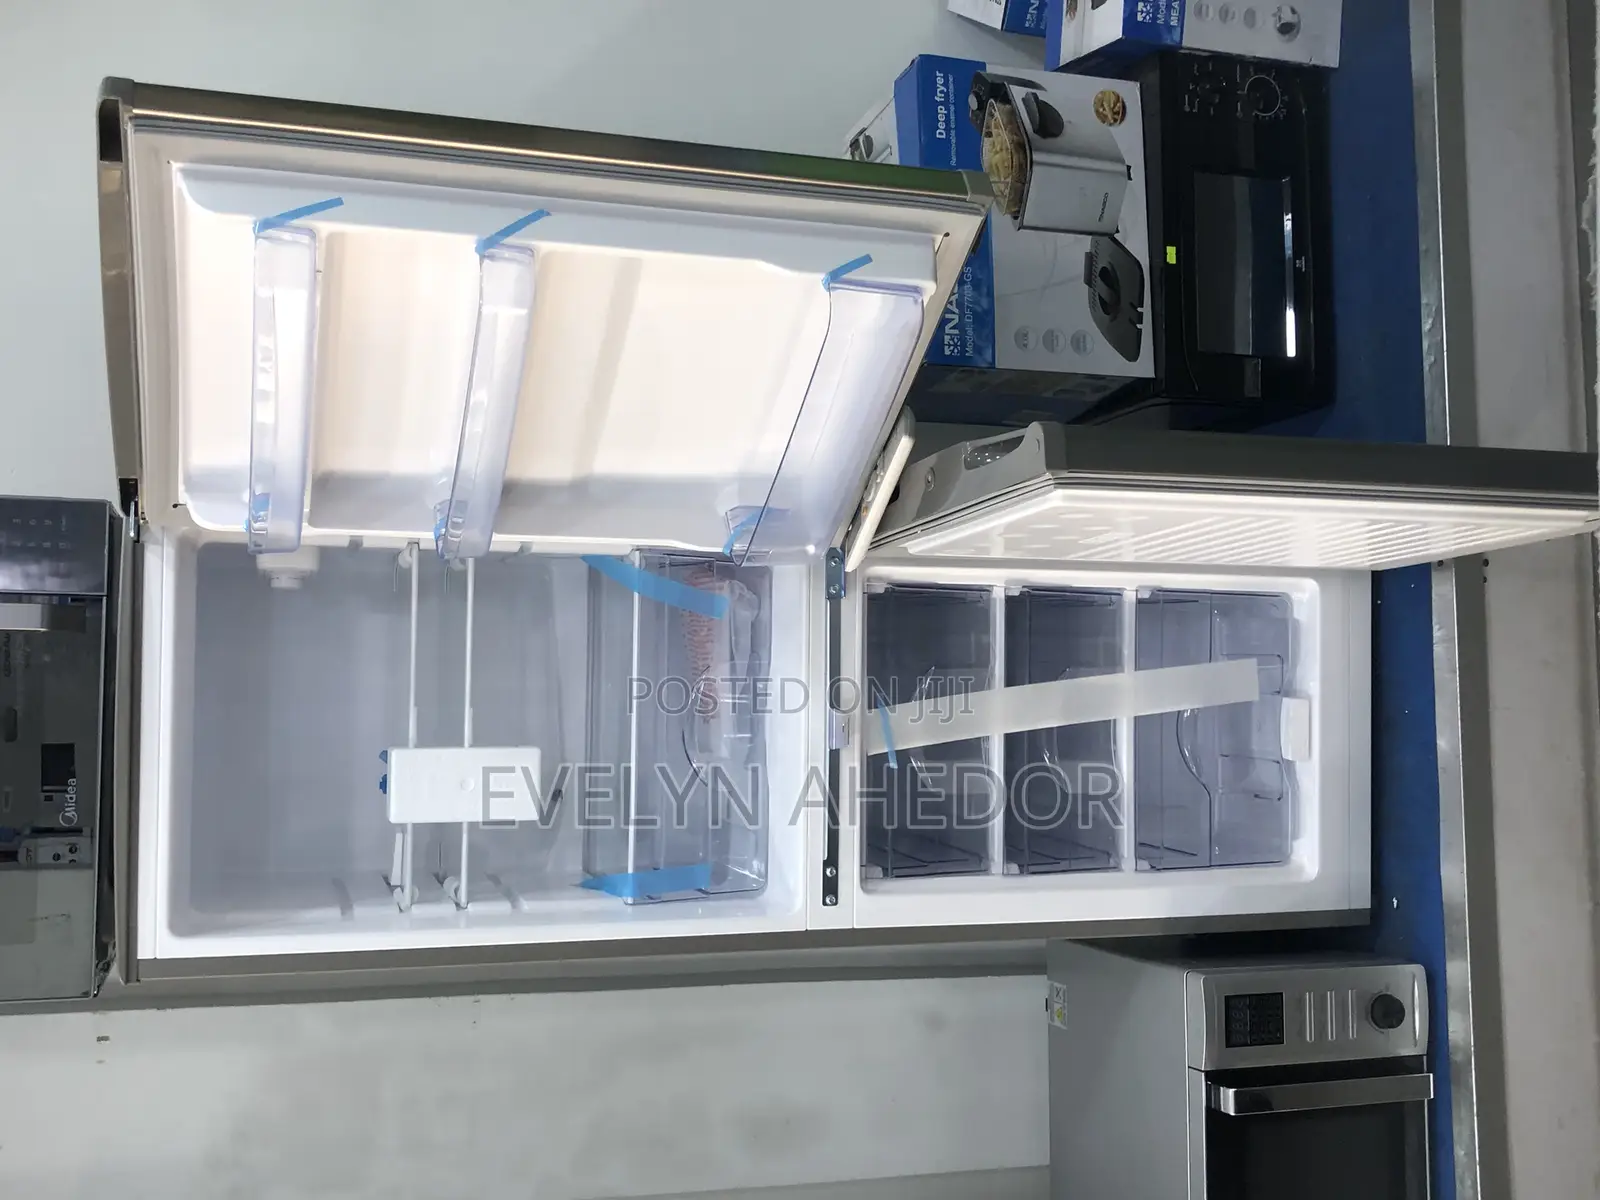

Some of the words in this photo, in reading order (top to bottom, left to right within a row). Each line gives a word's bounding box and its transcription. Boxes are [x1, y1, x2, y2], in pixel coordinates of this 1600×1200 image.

[934, 70, 946, 102] fryer
[947, 74, 955, 103] container
[936, 105, 948, 139] Deep
[964, 324, 974, 356] Model:
[63, 778, 77, 819] Midea
